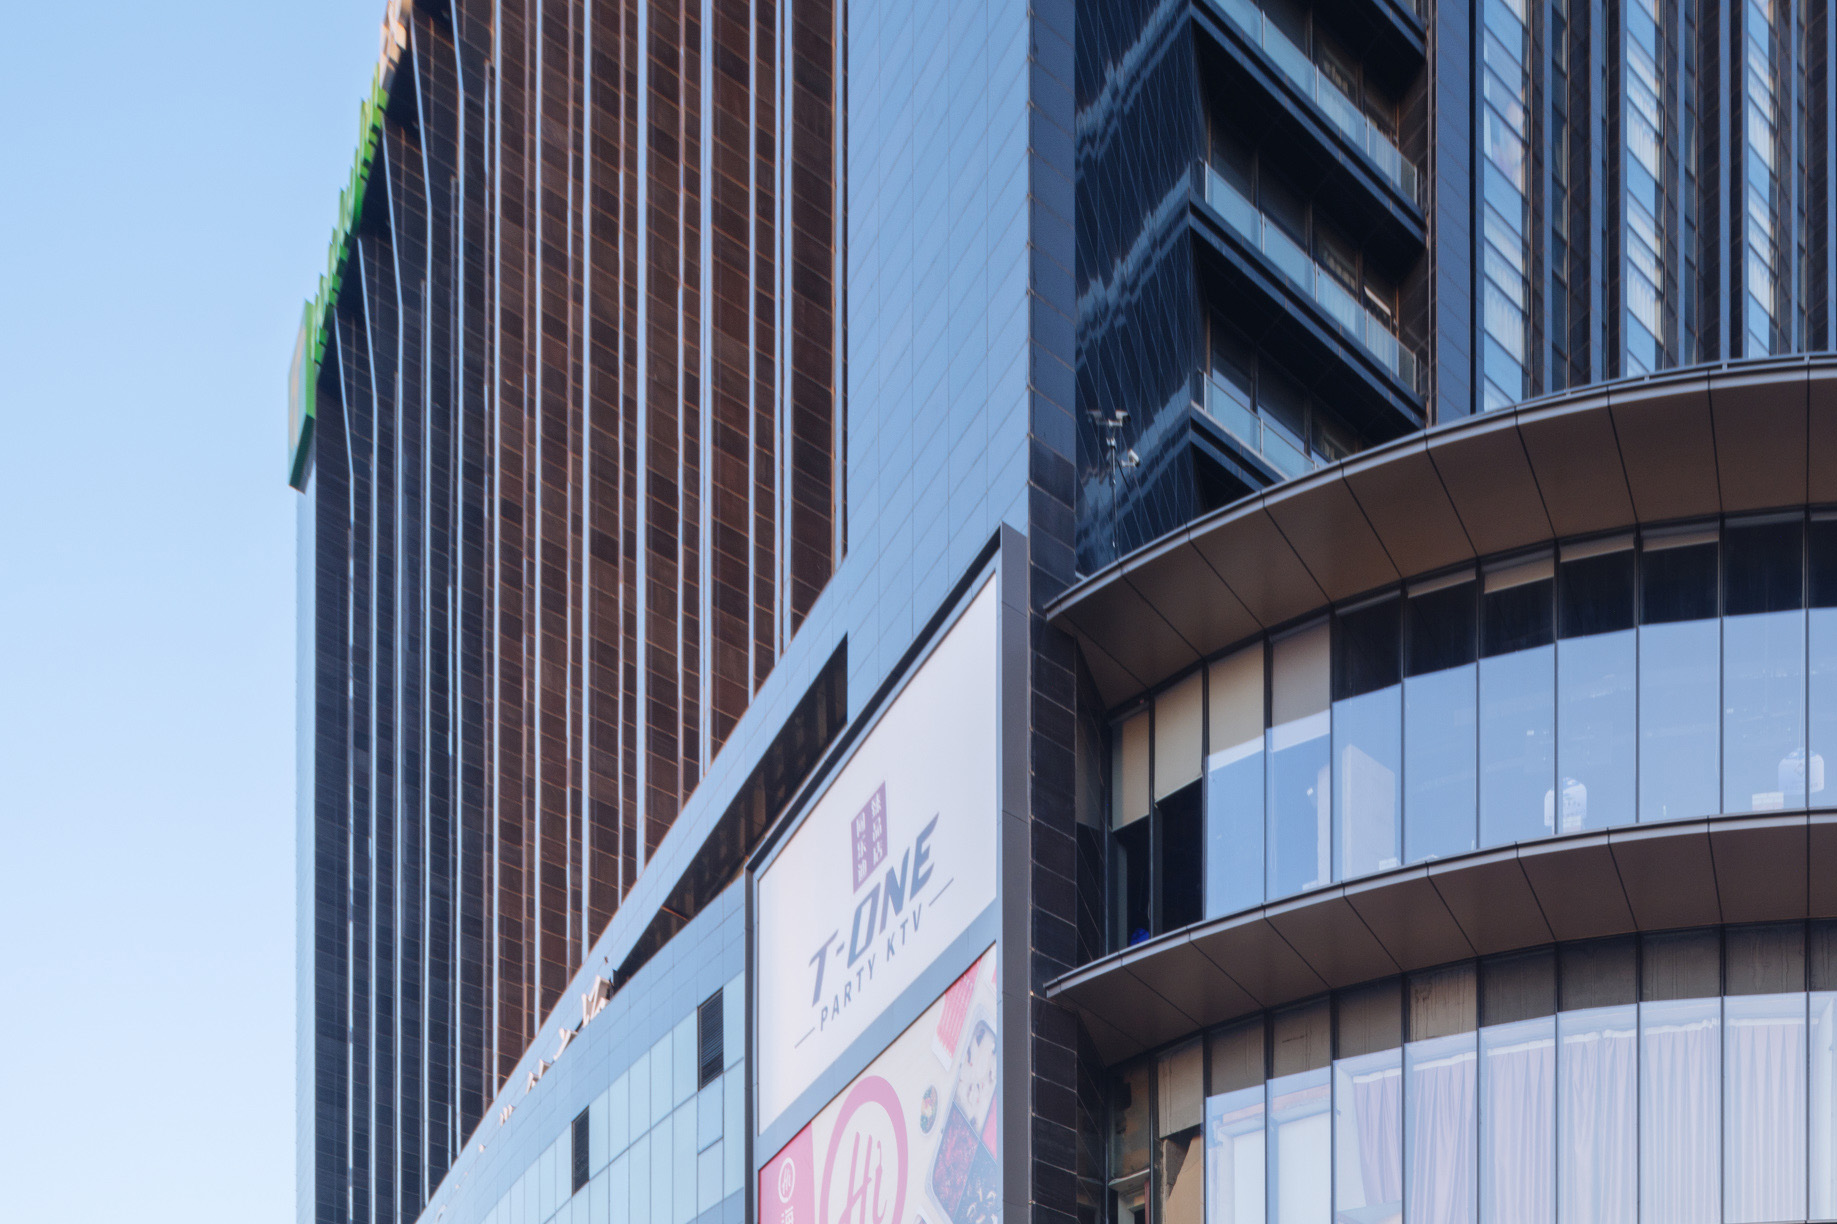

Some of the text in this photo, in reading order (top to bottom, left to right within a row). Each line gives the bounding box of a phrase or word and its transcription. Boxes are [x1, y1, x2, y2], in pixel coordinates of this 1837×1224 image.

[809, 811, 940, 1008] T-ONE
[820, 903, 922, 1032] PARTY KTV
